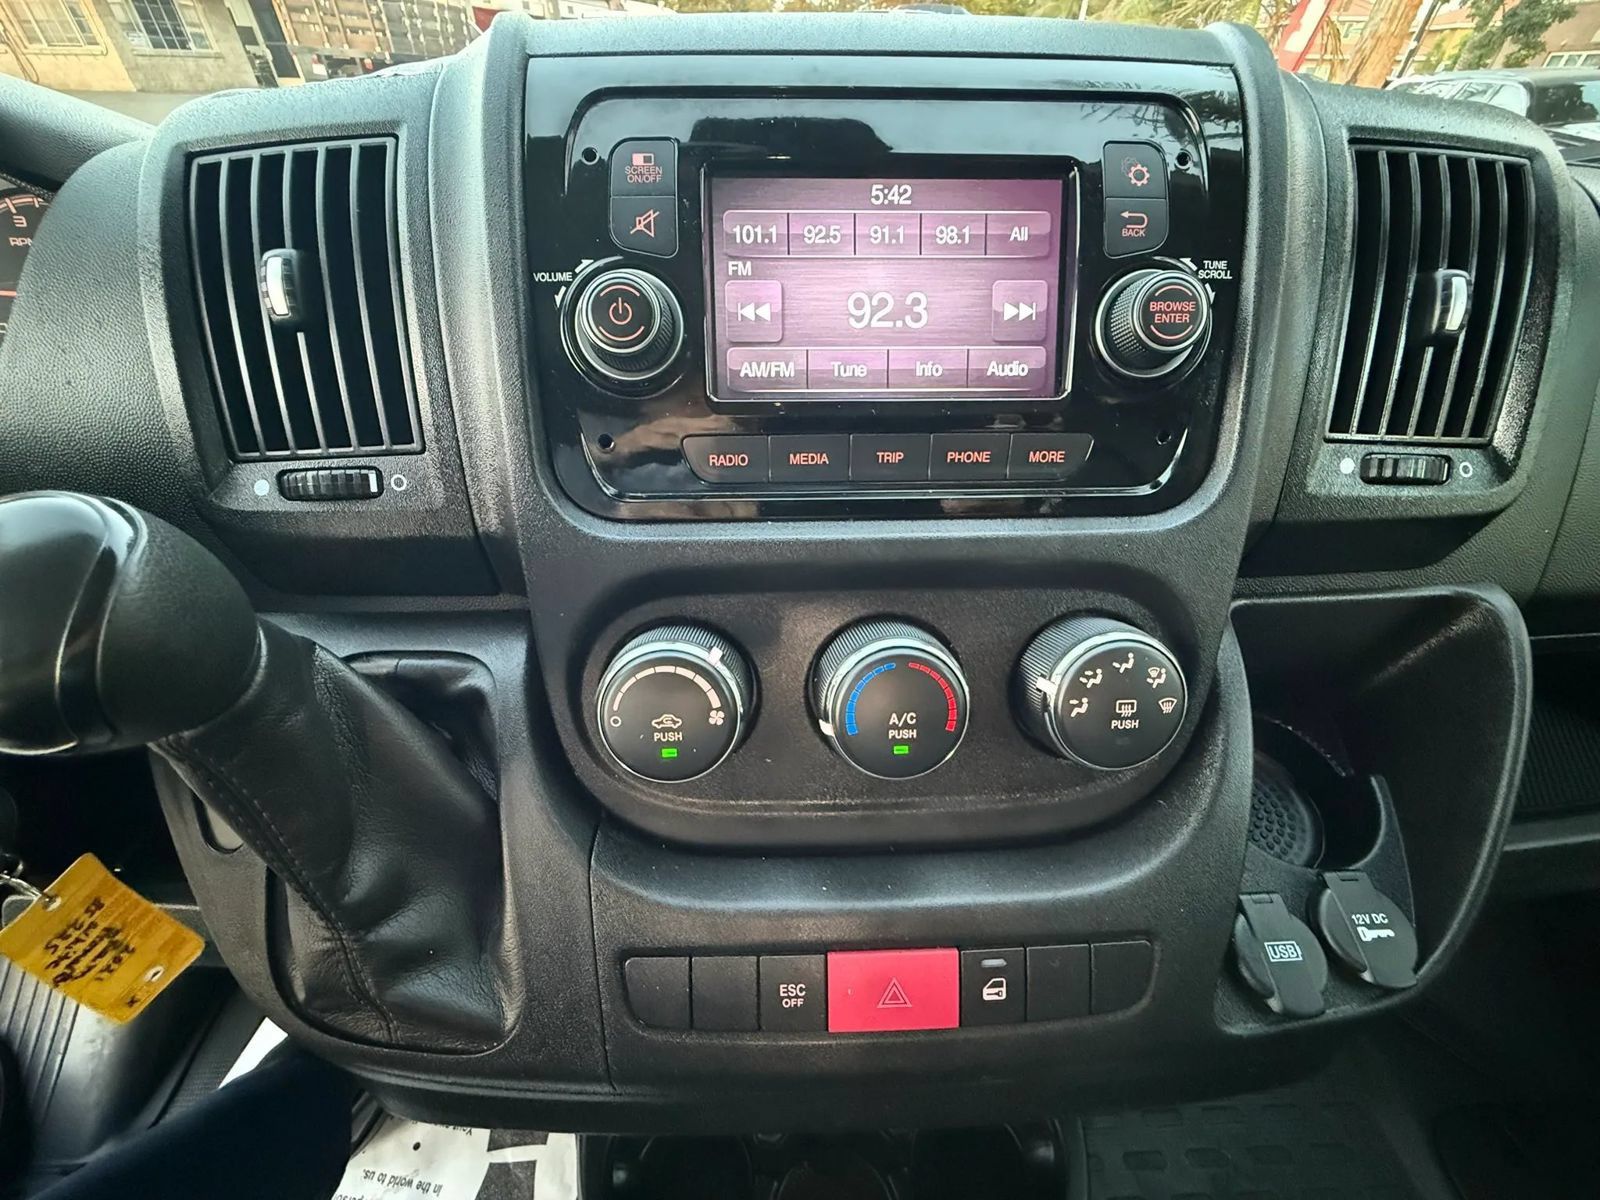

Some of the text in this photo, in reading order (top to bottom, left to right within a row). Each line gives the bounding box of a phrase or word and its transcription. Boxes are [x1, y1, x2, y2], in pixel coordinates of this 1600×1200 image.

[625, 166, 662, 175] SCREEN
[627, 174, 662, 183] ON/OFF
[870, 185, 912, 205] 5:42
[732, 226, 1029, 244] 101.1 92.5 91.1 98.1 All
[1121, 227, 1146, 237] BACK
[728, 263, 752, 276] FM
[1203, 260, 1228, 270] TUNE
[533, 272, 573, 282] VOLUME
[1198, 270, 1232, 280] SCROLL
[847, 291, 929, 330] 92.3
[1149, 301, 1196, 312] BROWSE
[1154, 312, 1191, 324] ENTER
[739, 360, 1029, 378] AM/FM Tune Info Audio
[709, 451, 1066, 467] RADIO MEDIA TRIP PHONE MORE
[888, 712, 917, 728] A/C
[1110, 718, 1140, 730] PUSH
[653, 731, 684, 742] PUSH
[888, 728, 917, 740] PUSH
[1351, 912, 1389, 926] 12V DC
[1267, 945, 1299, 960] USB
[778, 983, 806, 998] ESC
[781, 997, 805, 1009] OFF
[363, 1168, 444, 1198] in the world to us.
